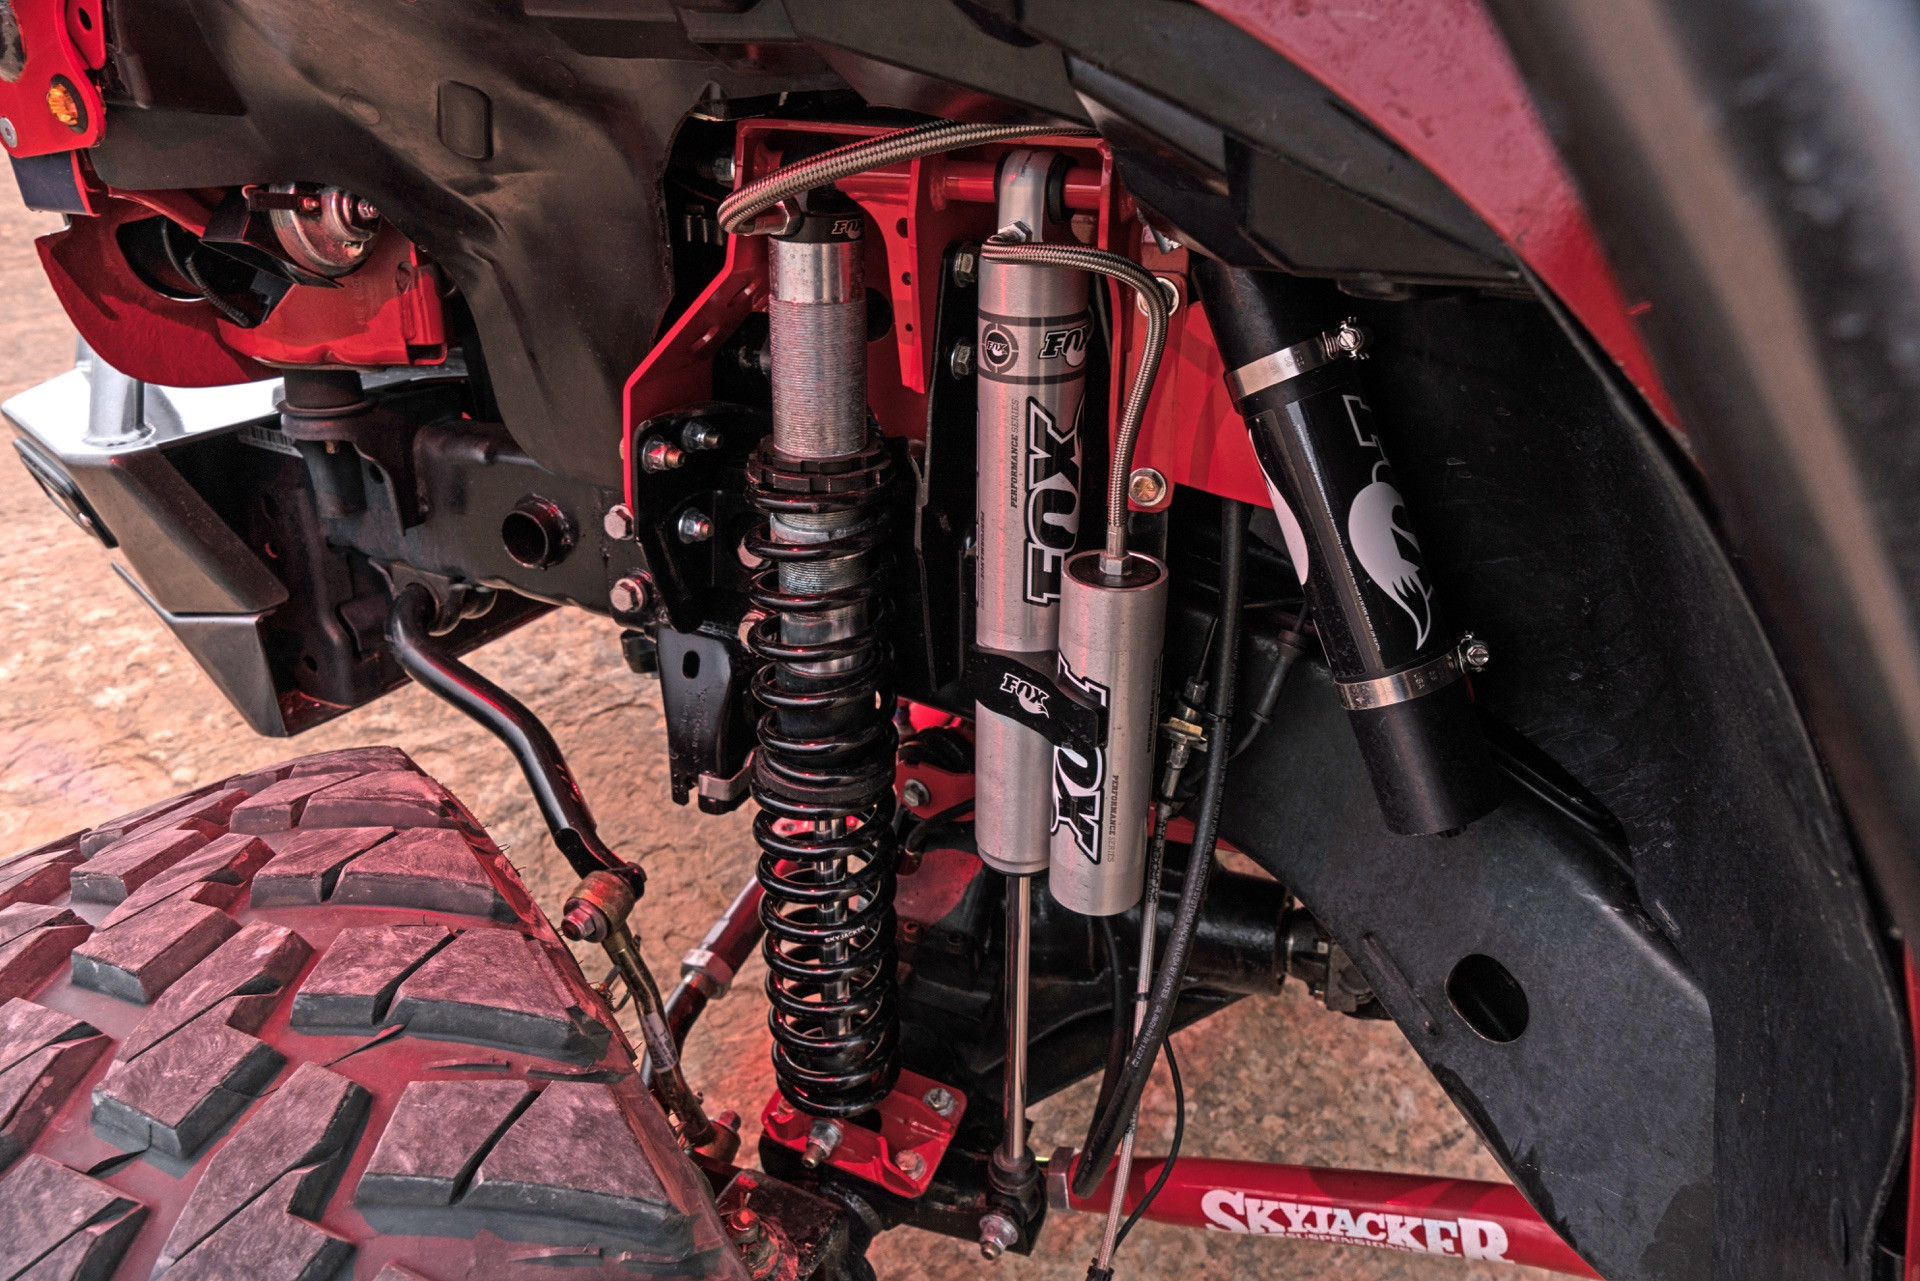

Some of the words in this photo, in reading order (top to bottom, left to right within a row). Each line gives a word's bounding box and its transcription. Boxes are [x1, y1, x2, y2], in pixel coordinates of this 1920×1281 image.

[986, 340, 1008, 355] FOX
[1011, 398, 1019, 434] SERIES
[1010, 434, 1019, 509] PERFORMANCE
[1000, 672, 1050, 716] FOX
[1109, 774, 1119, 835] PERFORMANCE
[1107, 835, 1116, 863] SERIES
[1185, 891, 1201, 923] SYSTEMS
[824, 924, 866, 943] SKYJACKER
[1178, 923, 1190, 942] MADE
[1168, 965, 1178, 979] BY
[1172, 950, 1182, 966] USA
[1201, 1189, 1516, 1264] SKYJACKER
